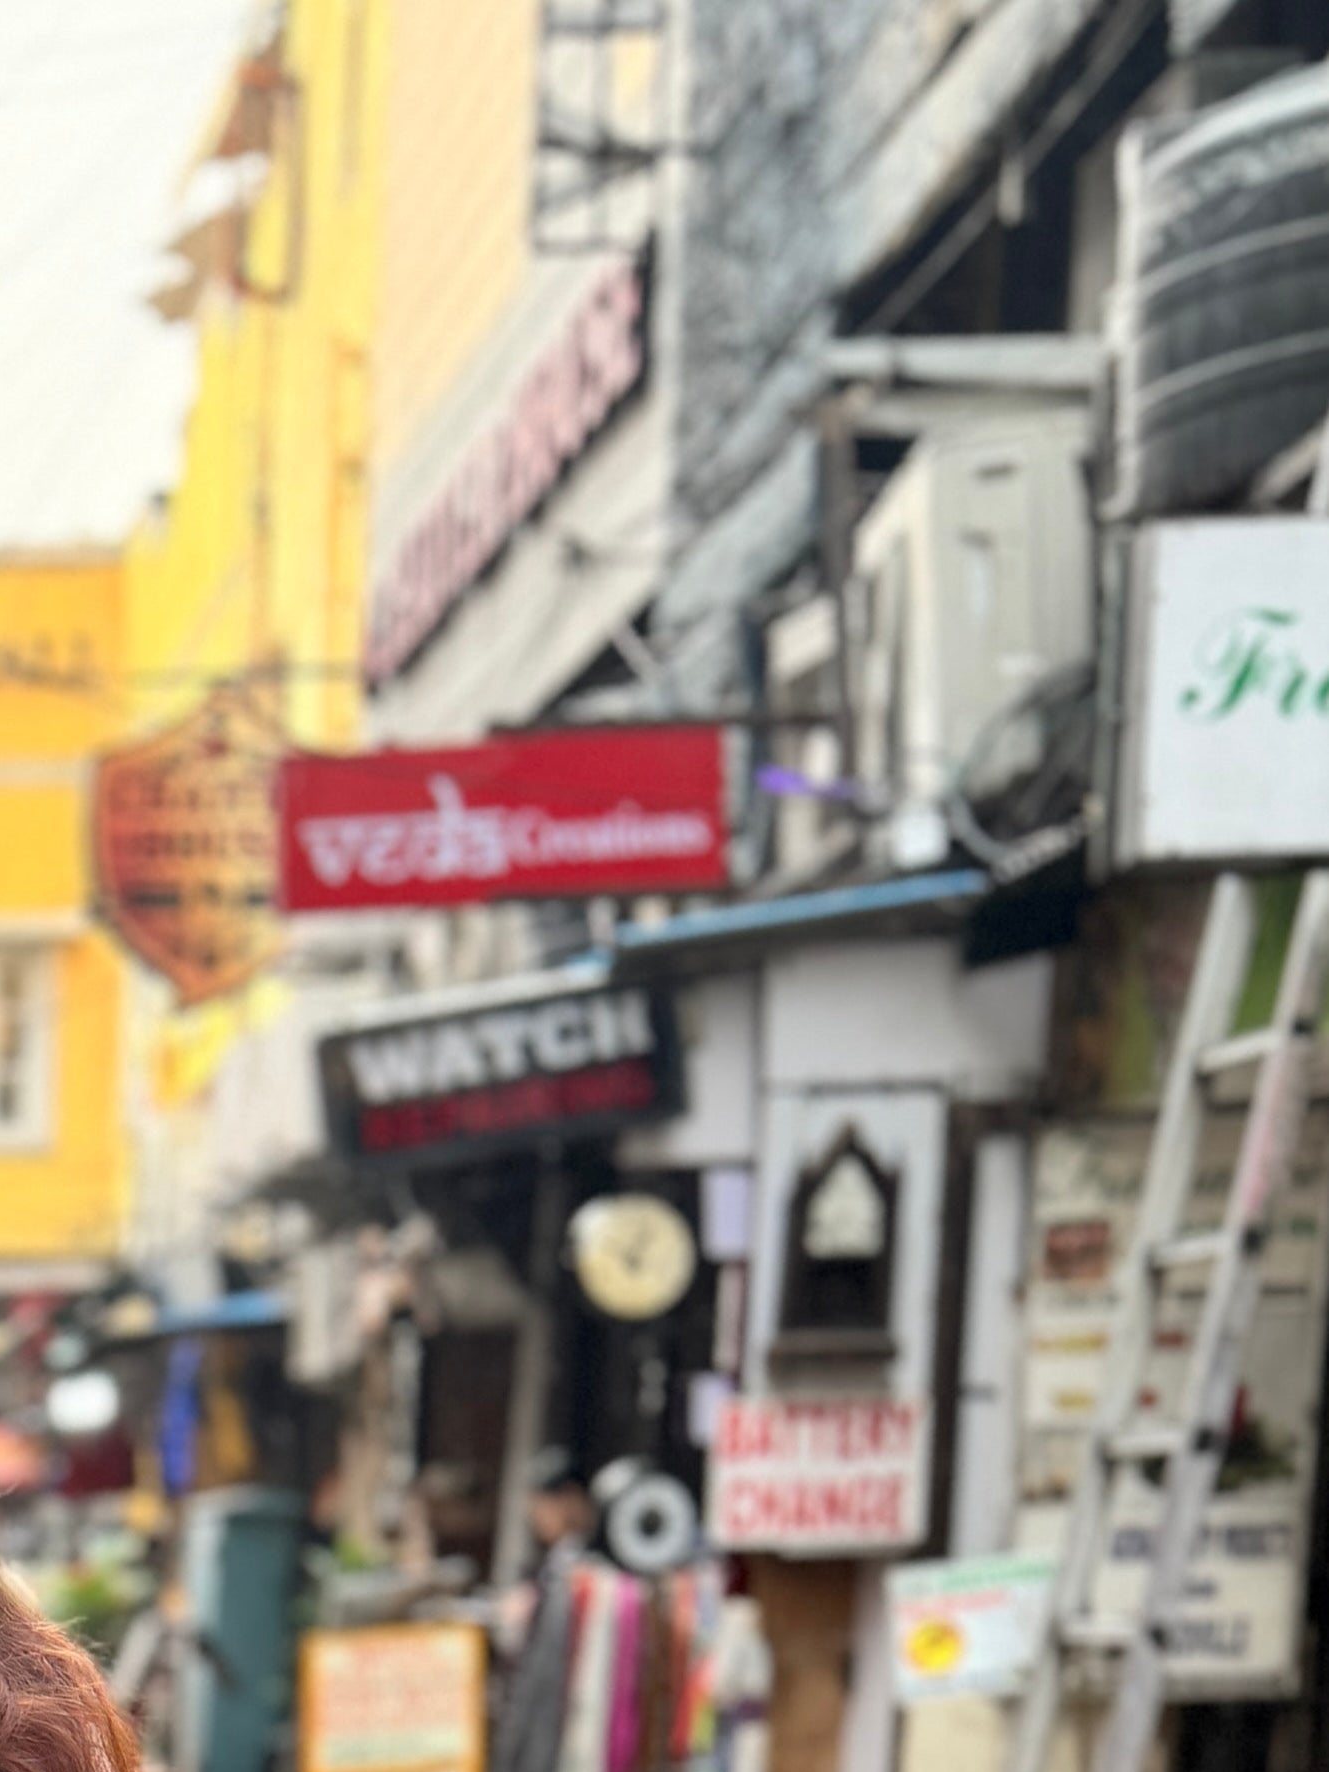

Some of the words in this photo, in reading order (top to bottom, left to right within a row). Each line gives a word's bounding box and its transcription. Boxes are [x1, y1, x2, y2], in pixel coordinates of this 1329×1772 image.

[347, 988, 655, 1104] WATCH
[716, 1399, 921, 1463] BATTERY
[724, 1474, 904, 1542] CHANGE
